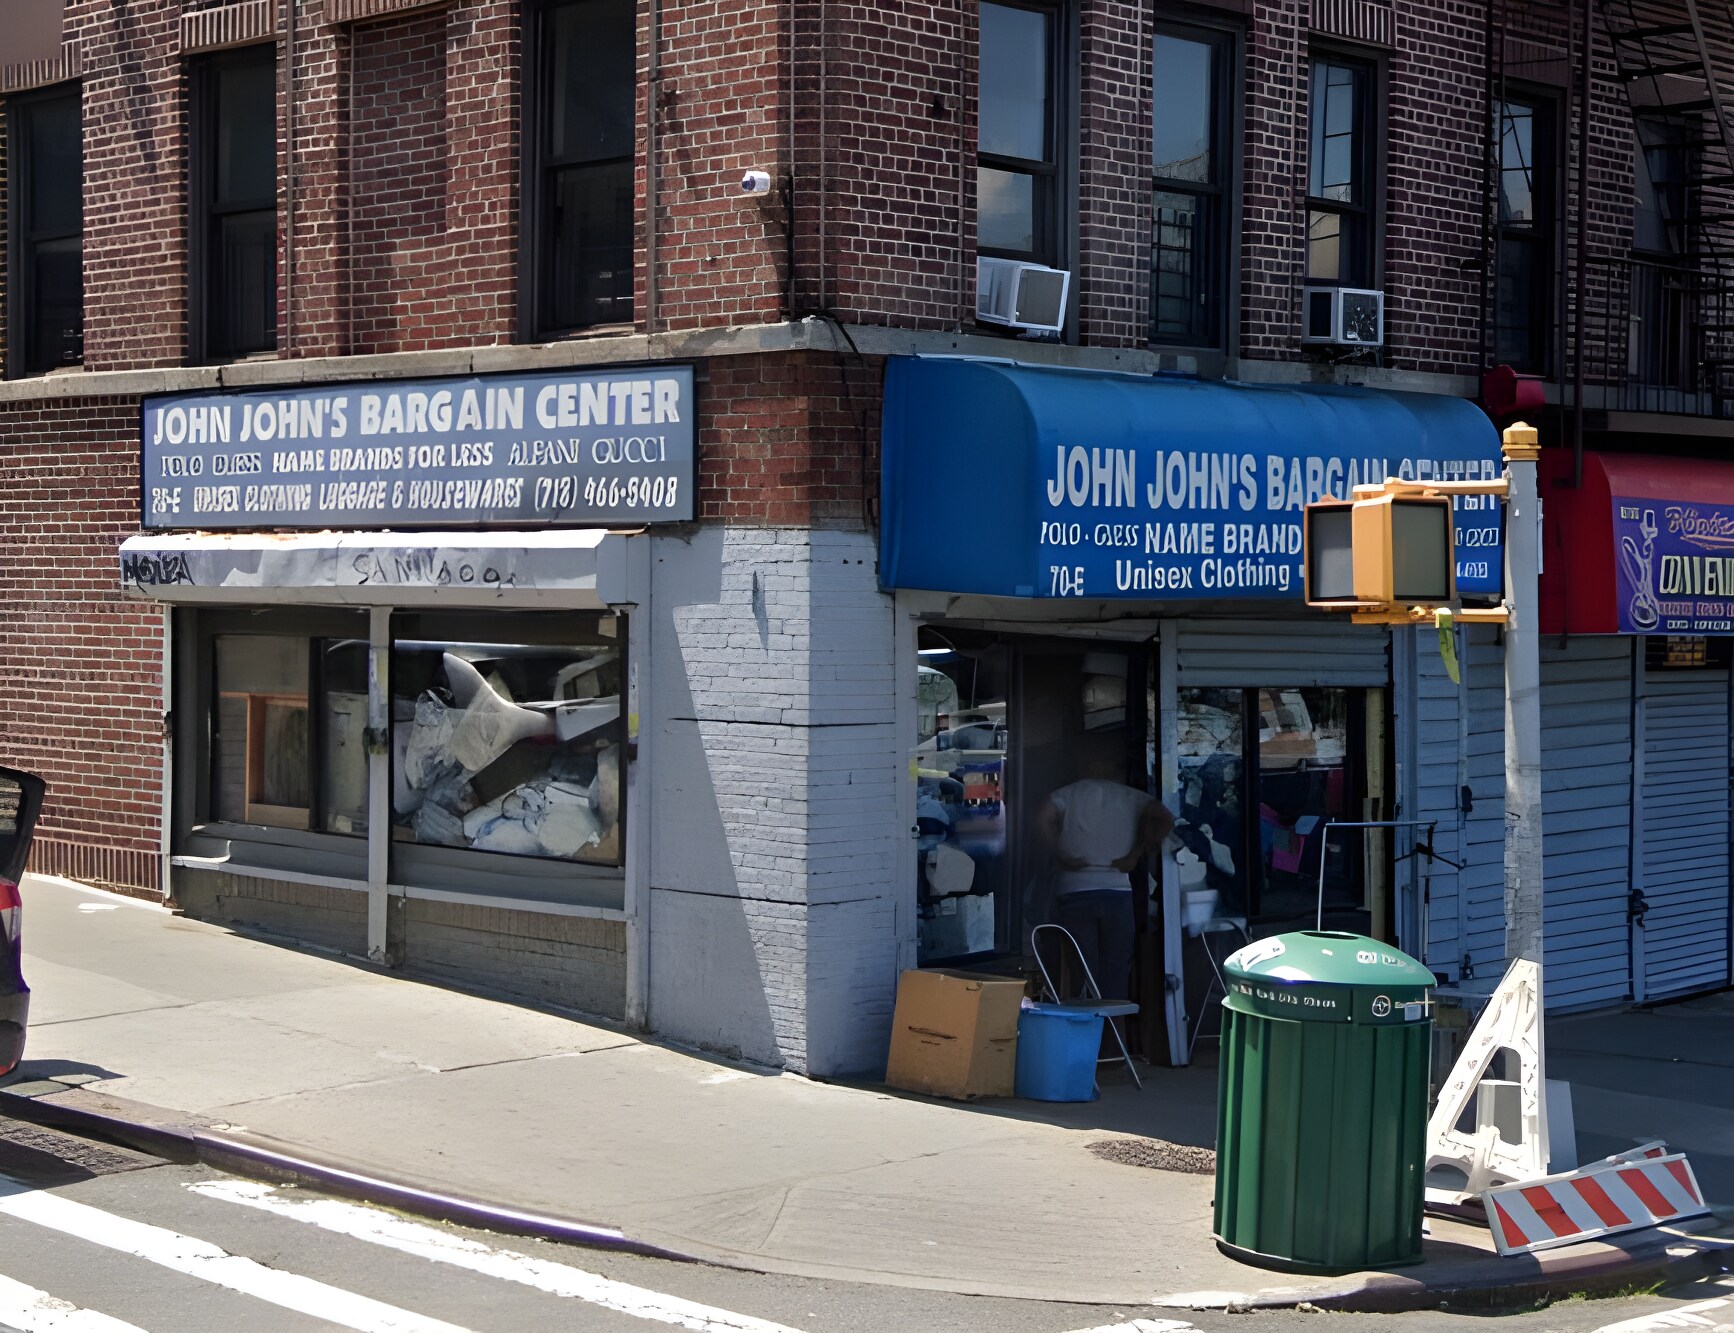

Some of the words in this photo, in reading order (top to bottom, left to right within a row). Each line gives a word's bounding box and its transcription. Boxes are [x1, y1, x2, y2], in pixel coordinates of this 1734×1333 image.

[153, 405, 231, 445] JOHN
[239, 396, 348, 442] JOHN'S
[359, 386, 525, 435] BARGAIN
[534, 378, 681, 430] CENTER
[407, 444, 447, 469] FOR
[450, 441, 494, 467] LESS
[591, 435, 666, 464] GUCCI
[1047, 444, 1136, 508] JOHN
[1146, 449, 1258, 512] JOHN'S
[1144, 521, 1215, 555] NAME
[1115, 558, 1193, 592] Unisex
[1200, 556, 1290, 592] Clothing
